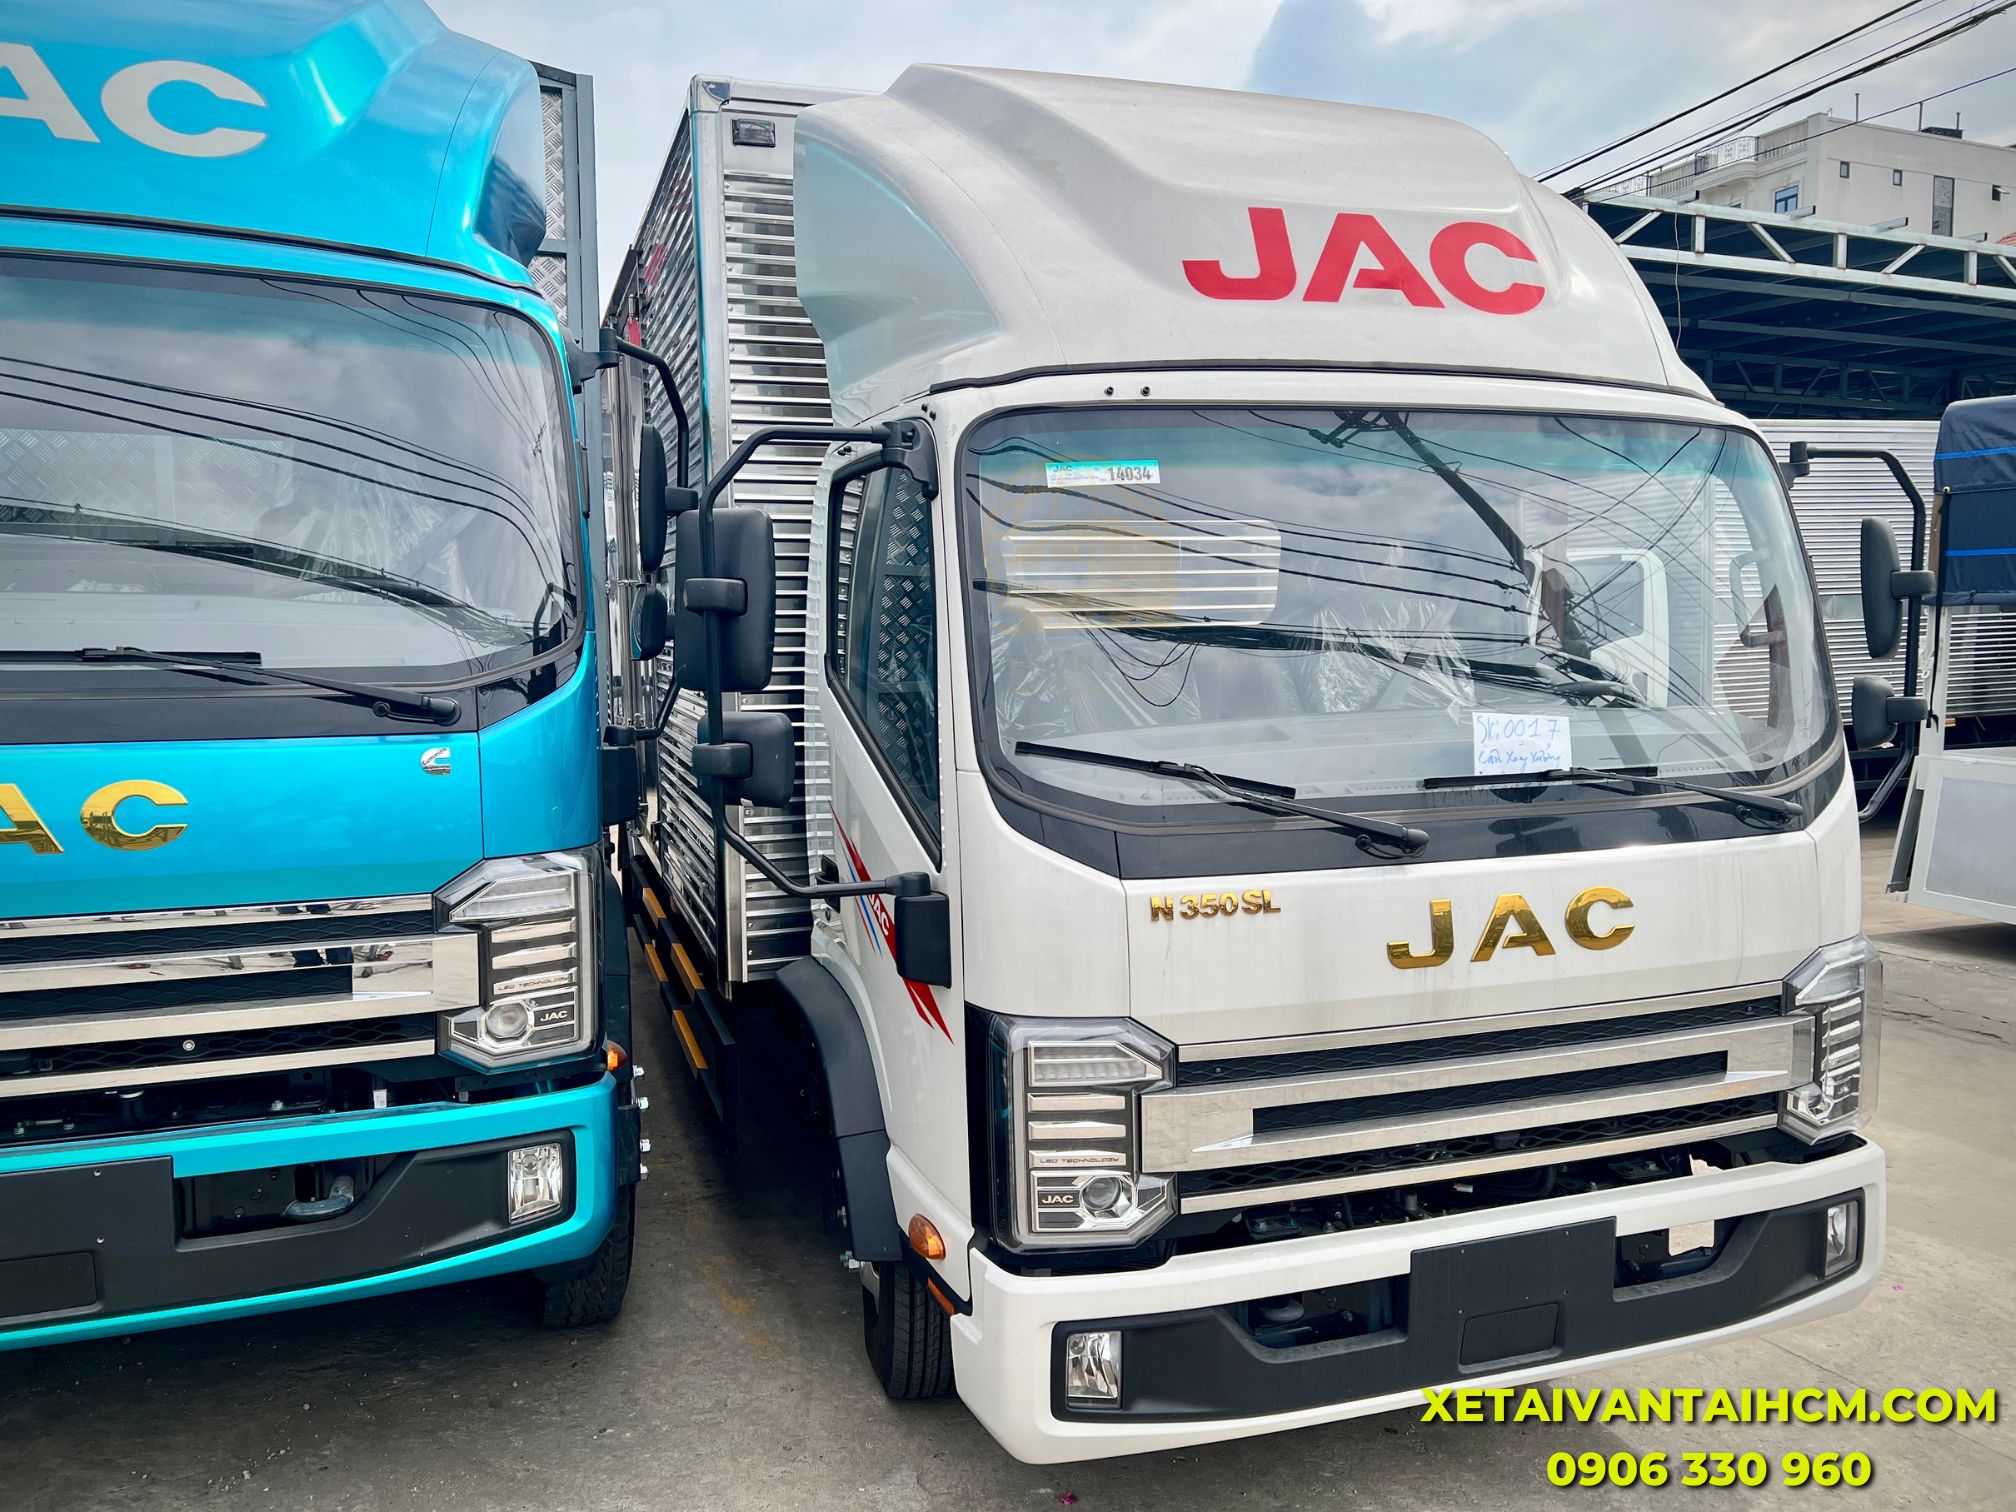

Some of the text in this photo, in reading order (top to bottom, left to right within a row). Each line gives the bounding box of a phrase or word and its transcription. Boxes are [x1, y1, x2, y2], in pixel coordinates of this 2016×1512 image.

[1182, 207, 1545, 315] JAC
[1107, 466, 1152, 481] 14034
[1387, 886, 1635, 970] JAC
[498, 983, 515, 991] LED
[540, 1010, 568, 1021] JAC
[1041, 1194, 1074, 1204] JAC
